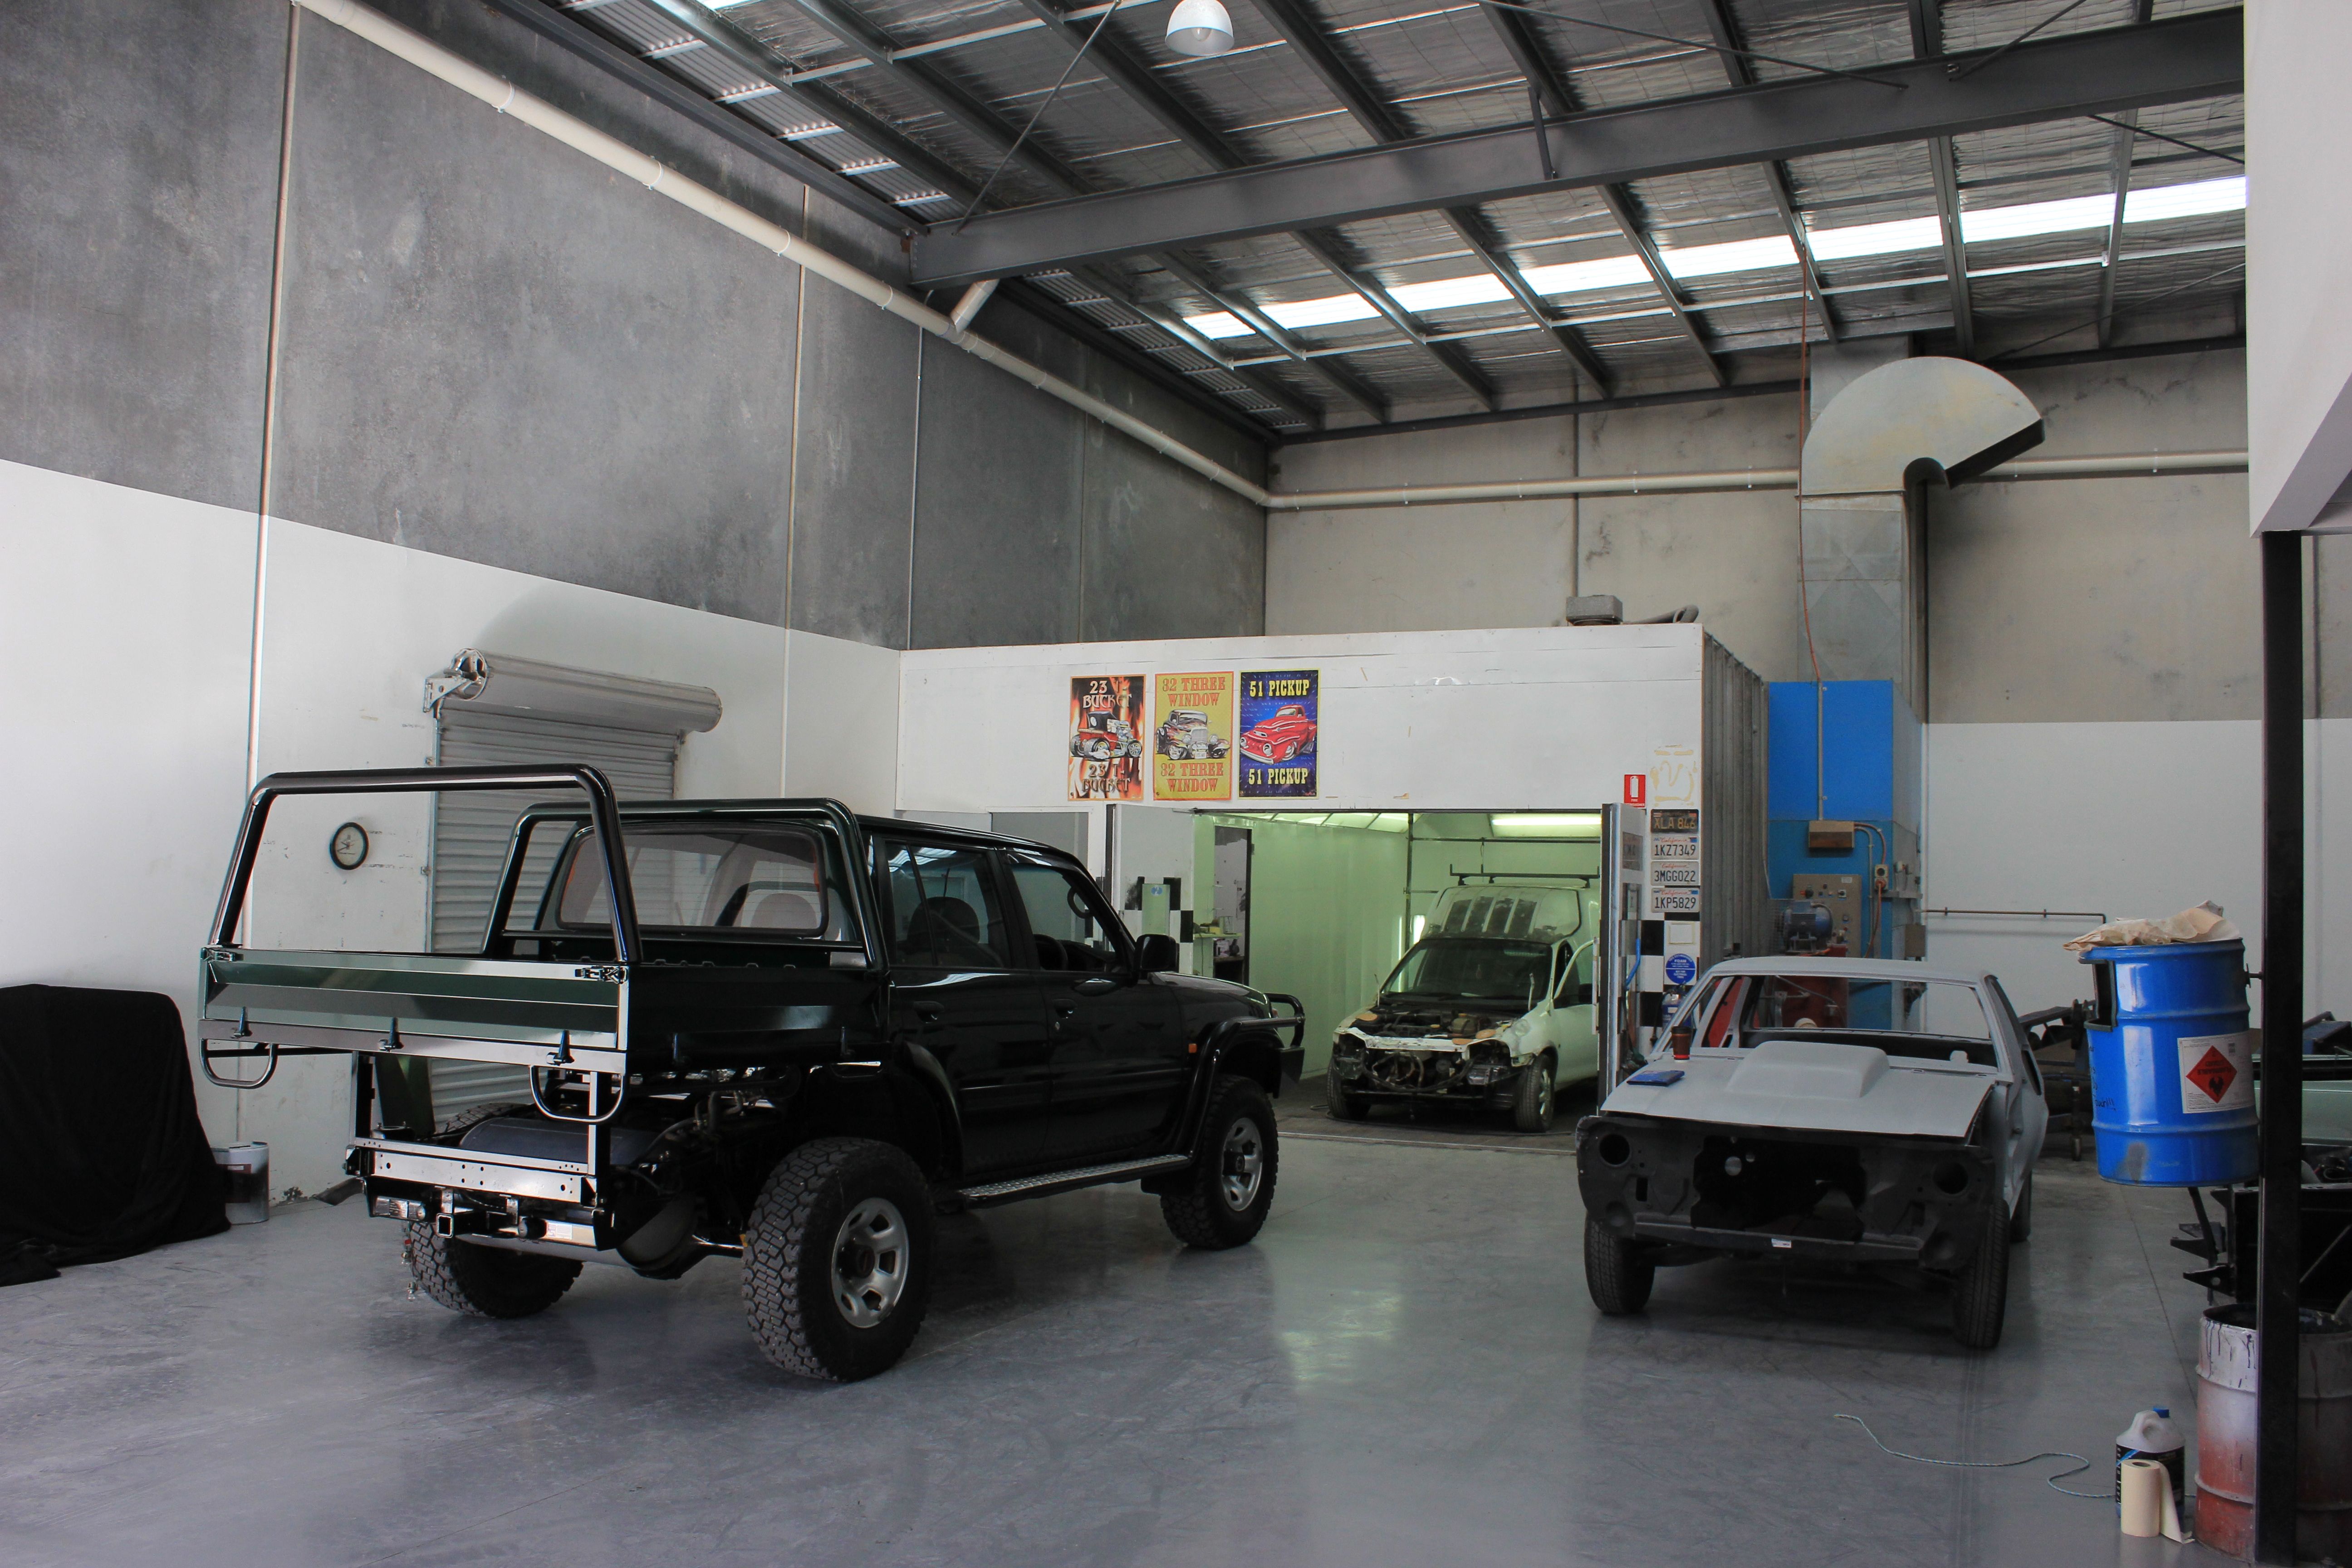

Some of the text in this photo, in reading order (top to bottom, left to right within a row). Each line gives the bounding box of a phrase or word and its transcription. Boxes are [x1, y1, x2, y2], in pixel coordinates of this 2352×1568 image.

[1089, 681, 1107, 694] 23
[1181, 676, 1225, 691] THREE
[1250, 679, 1309, 697] 51 PICKUP
[1083, 693, 1132, 709] BUCKET
[1168, 692, 1220, 706] WINDOW
[1089, 764, 1106, 777] 23
[1180, 762, 1224, 776] THREE
[1249, 768, 1308, 784] 51 PICKUP
[1082, 777, 1131, 793] BUCKET
[1166, 778, 1218, 792] WINDOW
[1654, 817, 1674, 829] XLA
[1654, 844, 1696, 856] 1KZ7349
[1654, 870, 1695, 882] 3MGG022
[1655, 897, 1696, 909] 1KP5829
